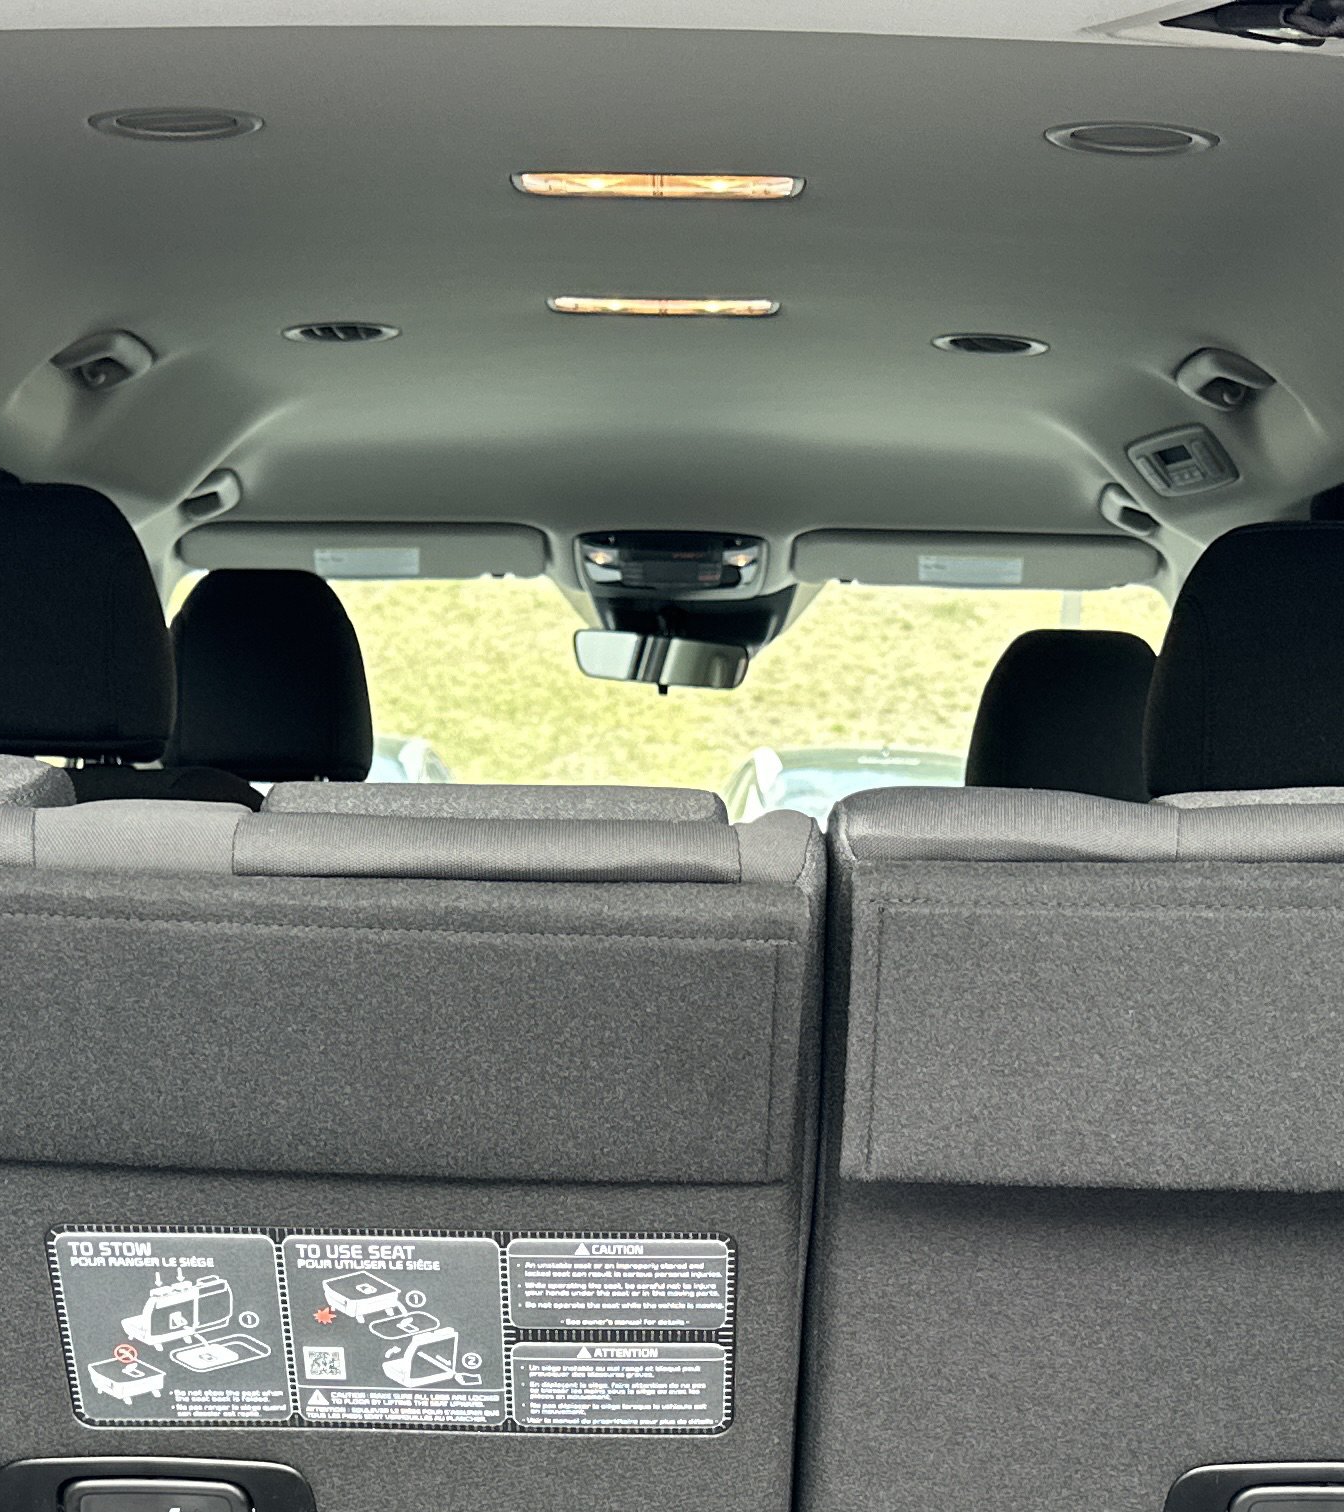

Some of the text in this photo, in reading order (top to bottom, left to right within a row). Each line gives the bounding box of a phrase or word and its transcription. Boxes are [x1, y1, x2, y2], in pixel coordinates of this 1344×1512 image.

[69, 1241, 151, 1256] TO STOW
[296, 1243, 415, 1259] TO USE SEAT
[592, 1244, 643, 1254] CAUTION
[70, 1255, 214, 1267] POUR RANGER LE SIÈGE
[297, 1258, 440, 1270] POUR UTILISER LE SIÈGE
[594, 1346, 658, 1357] ATTENTION
